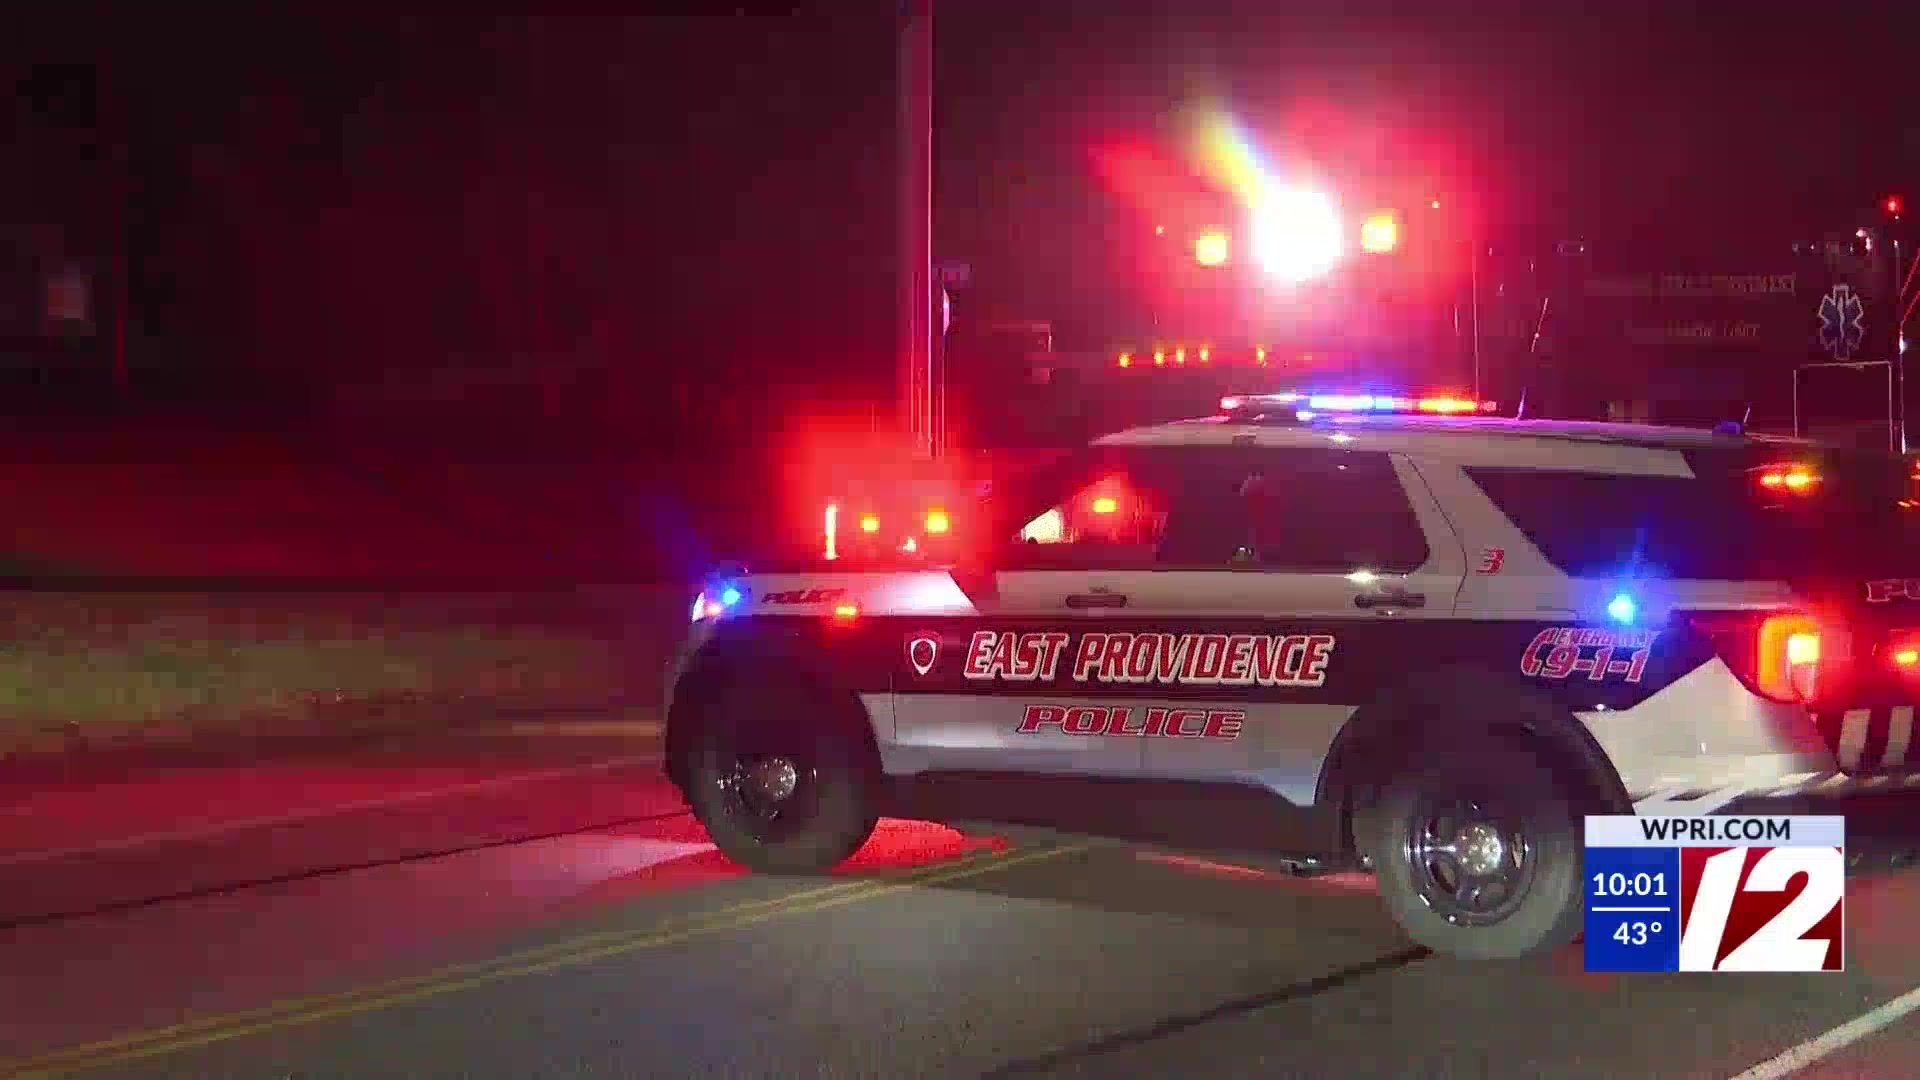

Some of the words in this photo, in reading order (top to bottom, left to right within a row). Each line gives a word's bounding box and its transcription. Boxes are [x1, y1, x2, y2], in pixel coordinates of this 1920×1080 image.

[1477, 547, 1504, 574] 3
[964, 631, 1069, 681] EAST
[1073, 633, 1335, 686] PROVIDENCE
[1540, 643, 1650, 683] 9-1-1
[1017, 705, 1245, 740] POLICE
